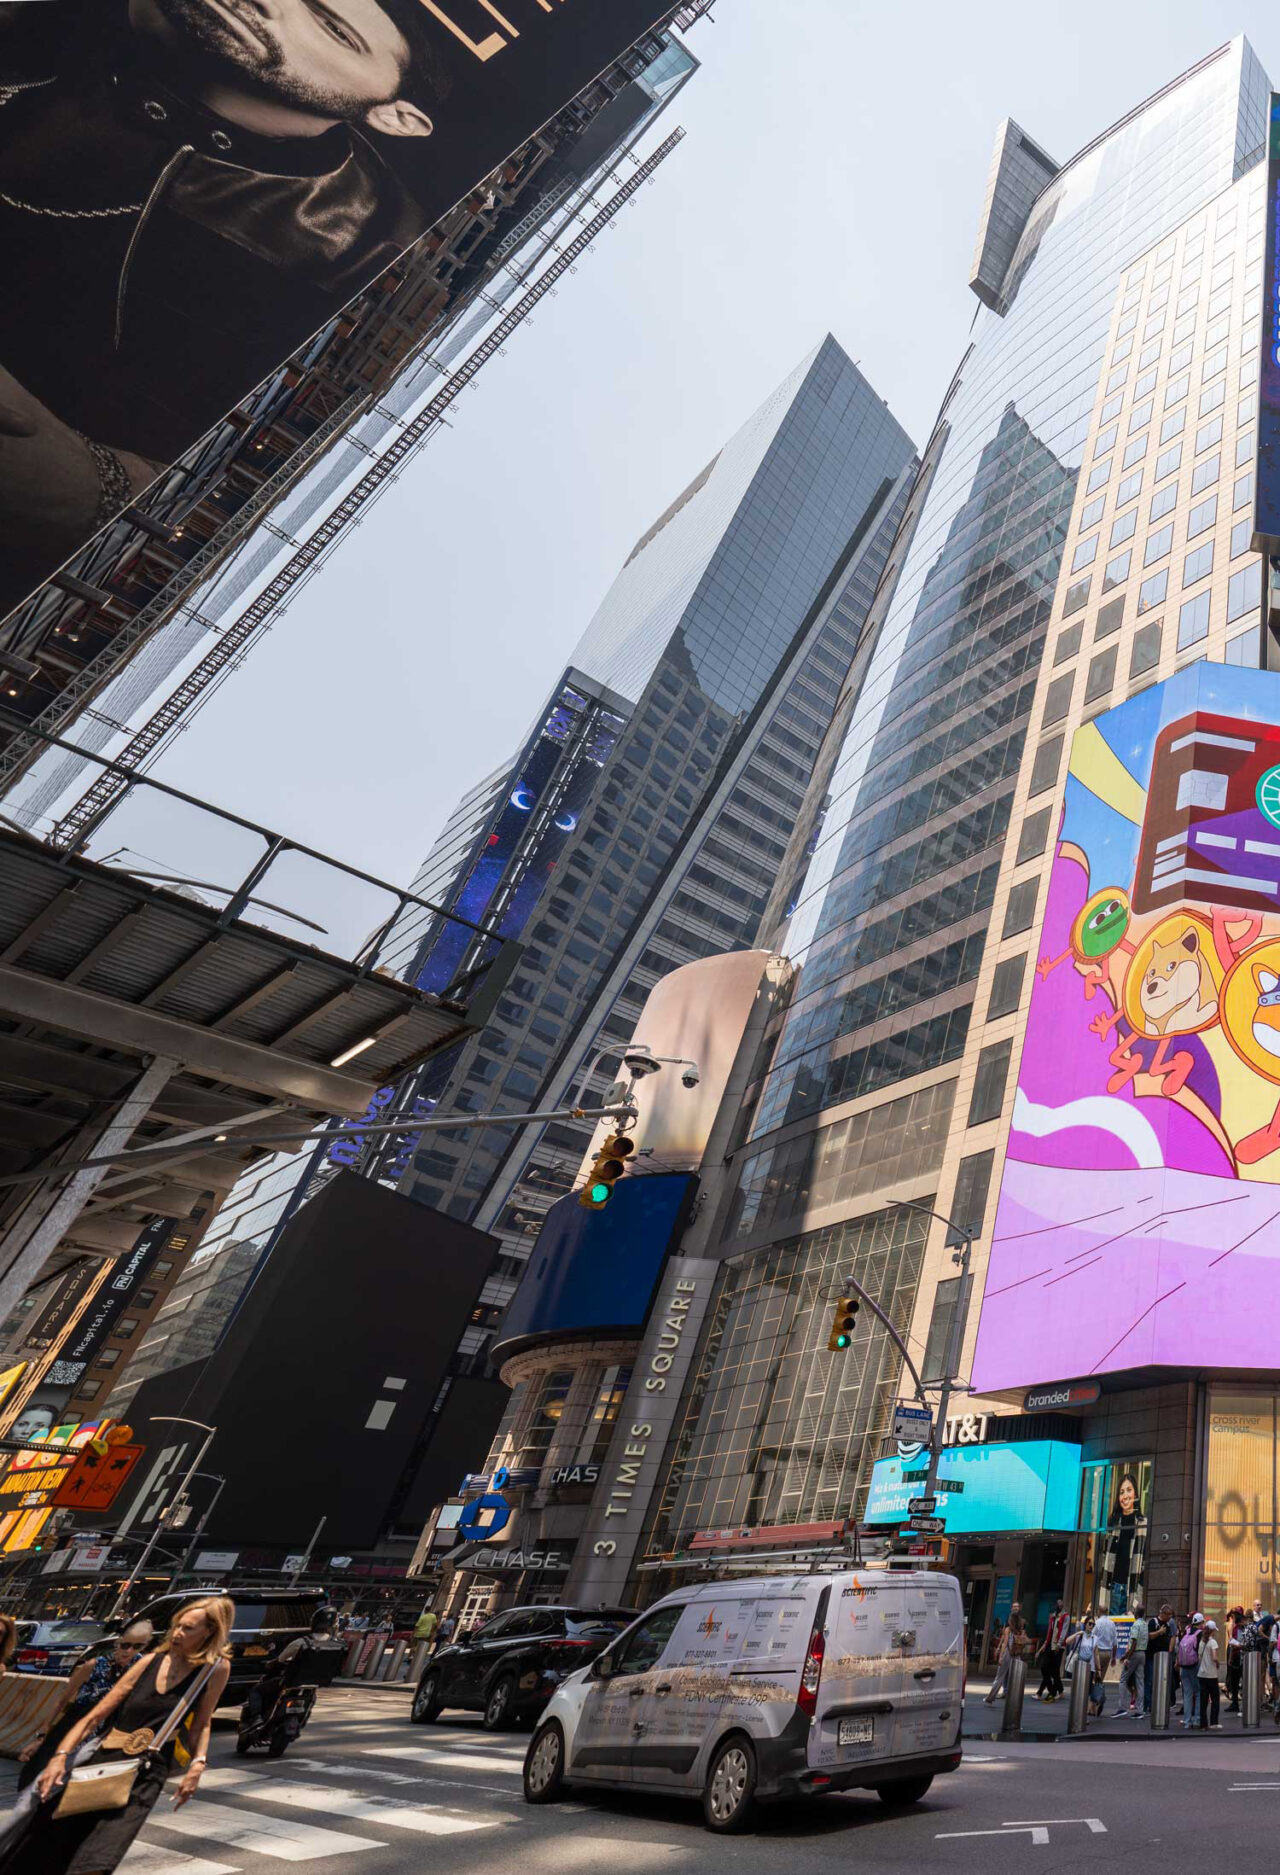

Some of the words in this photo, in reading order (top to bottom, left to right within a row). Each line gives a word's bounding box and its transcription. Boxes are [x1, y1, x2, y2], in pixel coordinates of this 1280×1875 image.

[124, 1241, 152, 1276] CAPITAL
[72, 1298, 115, 1358] FNcapital.io
[644, 1279, 697, 1392] SQUARE
[1212, 1416, 1238, 1425] cross
[1238, 1416, 1261, 1425] river
[1212, 1424, 1250, 1436] campus
[604, 1422, 653, 1518] TIMES
[913, 1520, 924, 1528] ONE
[594, 1539, 617, 1557] 3
[474, 1550, 561, 1569] CHASE
[842, 1587, 878, 1598] SCIENTIFIC
[751, 1677, 778, 1689] Service
[685, 1690, 706, 1702] FDNY
[708, 1691, 747, 1705] Certificate
